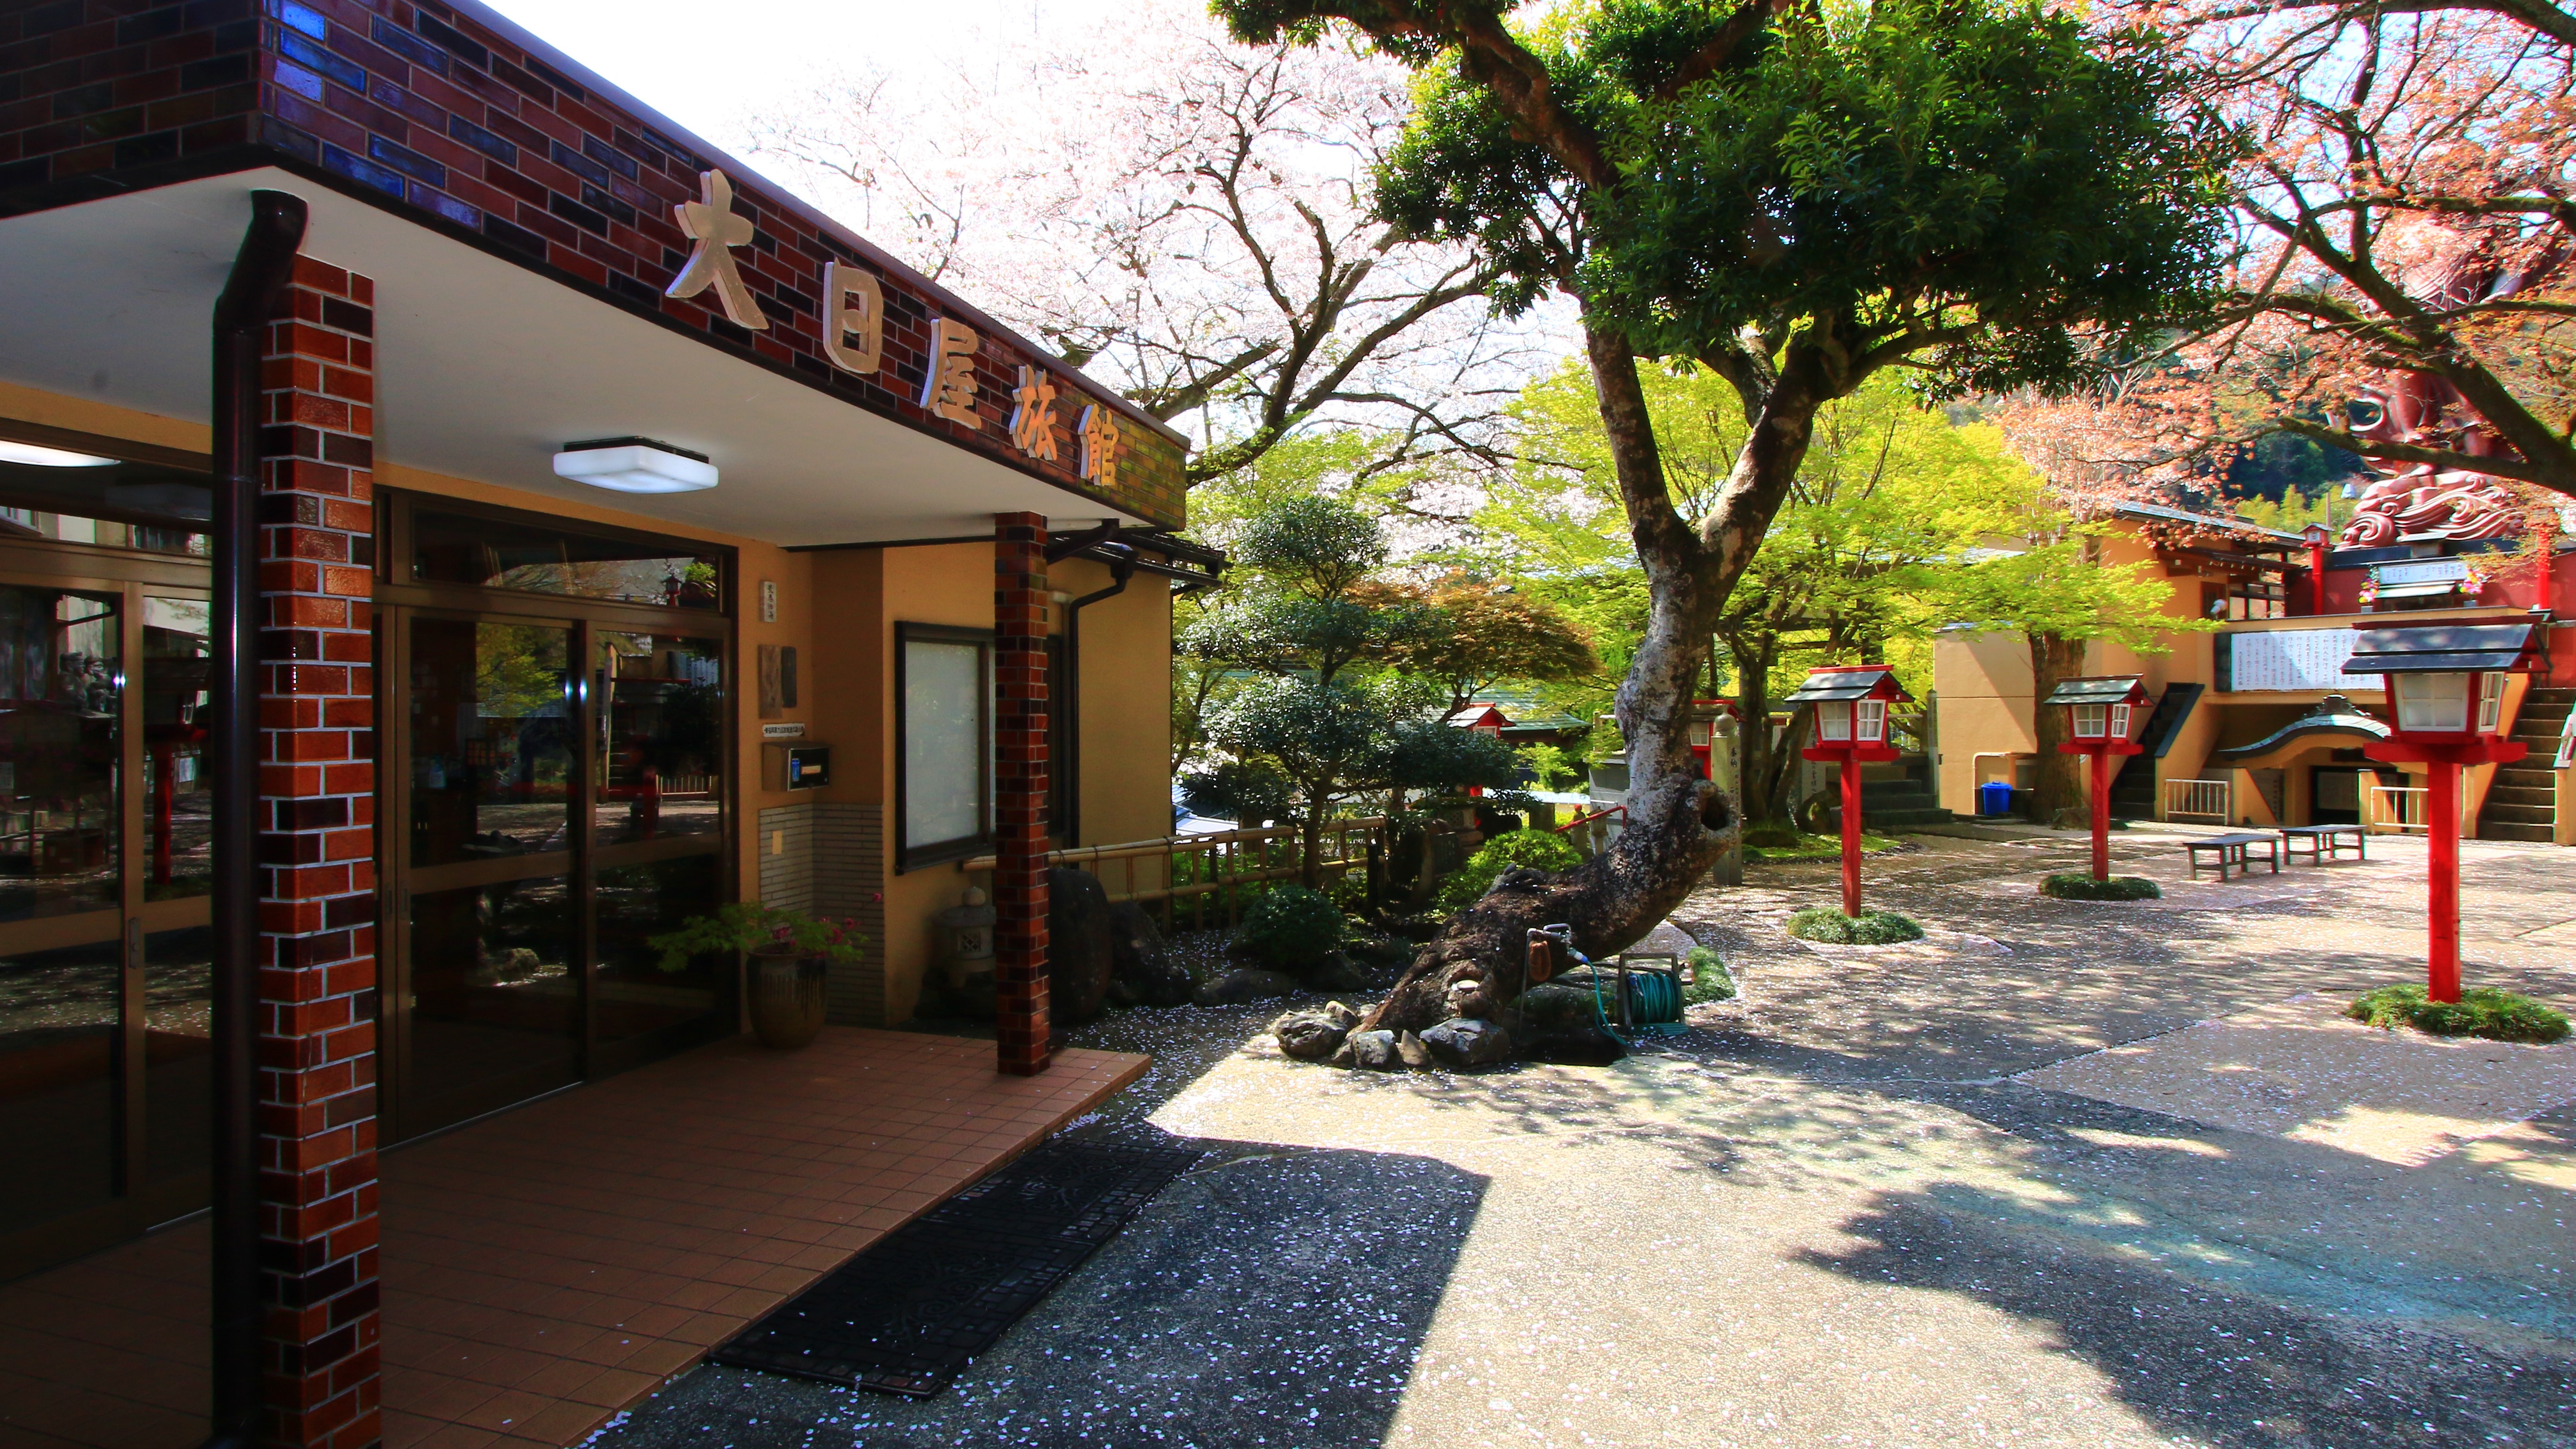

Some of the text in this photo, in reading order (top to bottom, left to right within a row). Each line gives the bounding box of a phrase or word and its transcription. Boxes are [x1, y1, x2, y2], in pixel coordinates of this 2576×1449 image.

[665, 169, 1119, 487] 大日屋旅館
